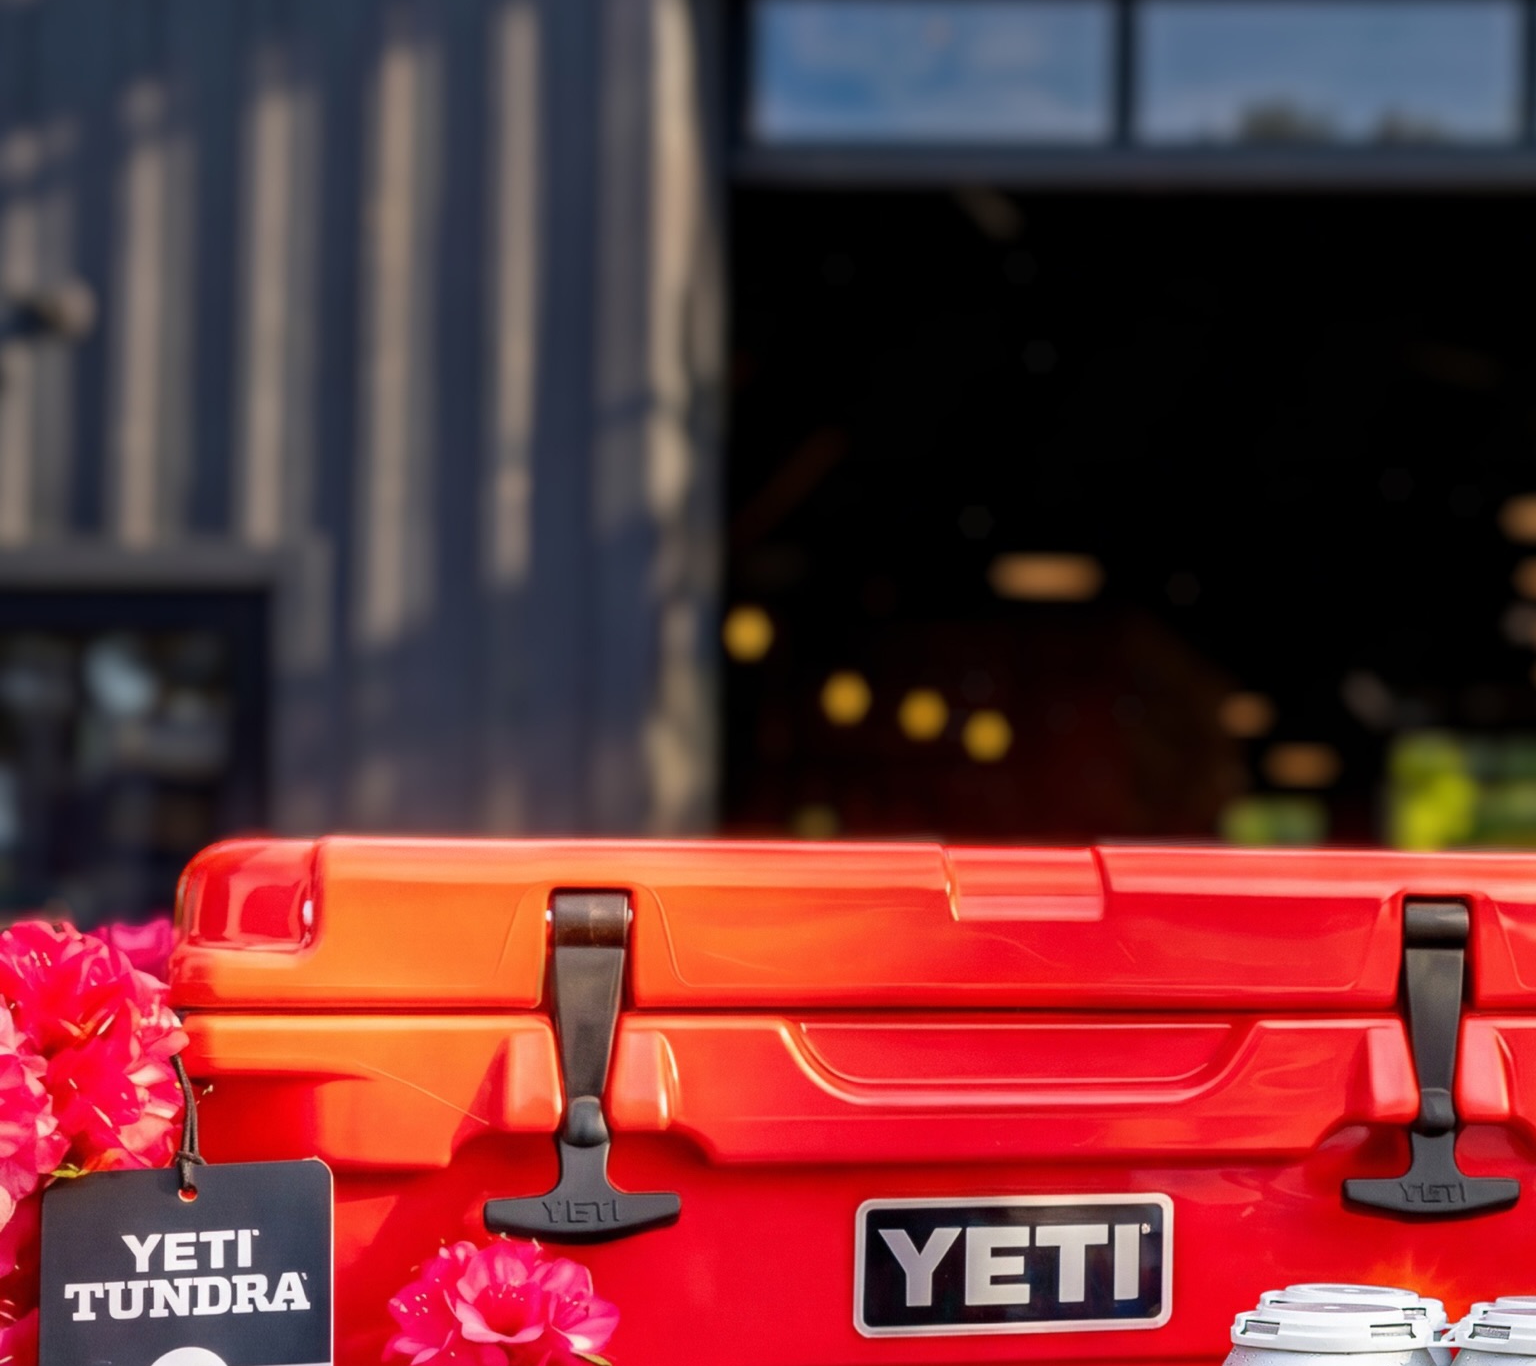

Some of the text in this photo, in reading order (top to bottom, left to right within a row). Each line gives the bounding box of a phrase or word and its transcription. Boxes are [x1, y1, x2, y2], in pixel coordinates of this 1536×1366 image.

[542, 1199, 620, 1223] YETI
[121, 1229, 253, 1273] YETI
[878, 1223, 1141, 1307] YETI
[64, 1271, 311, 1322] TUNDRA
